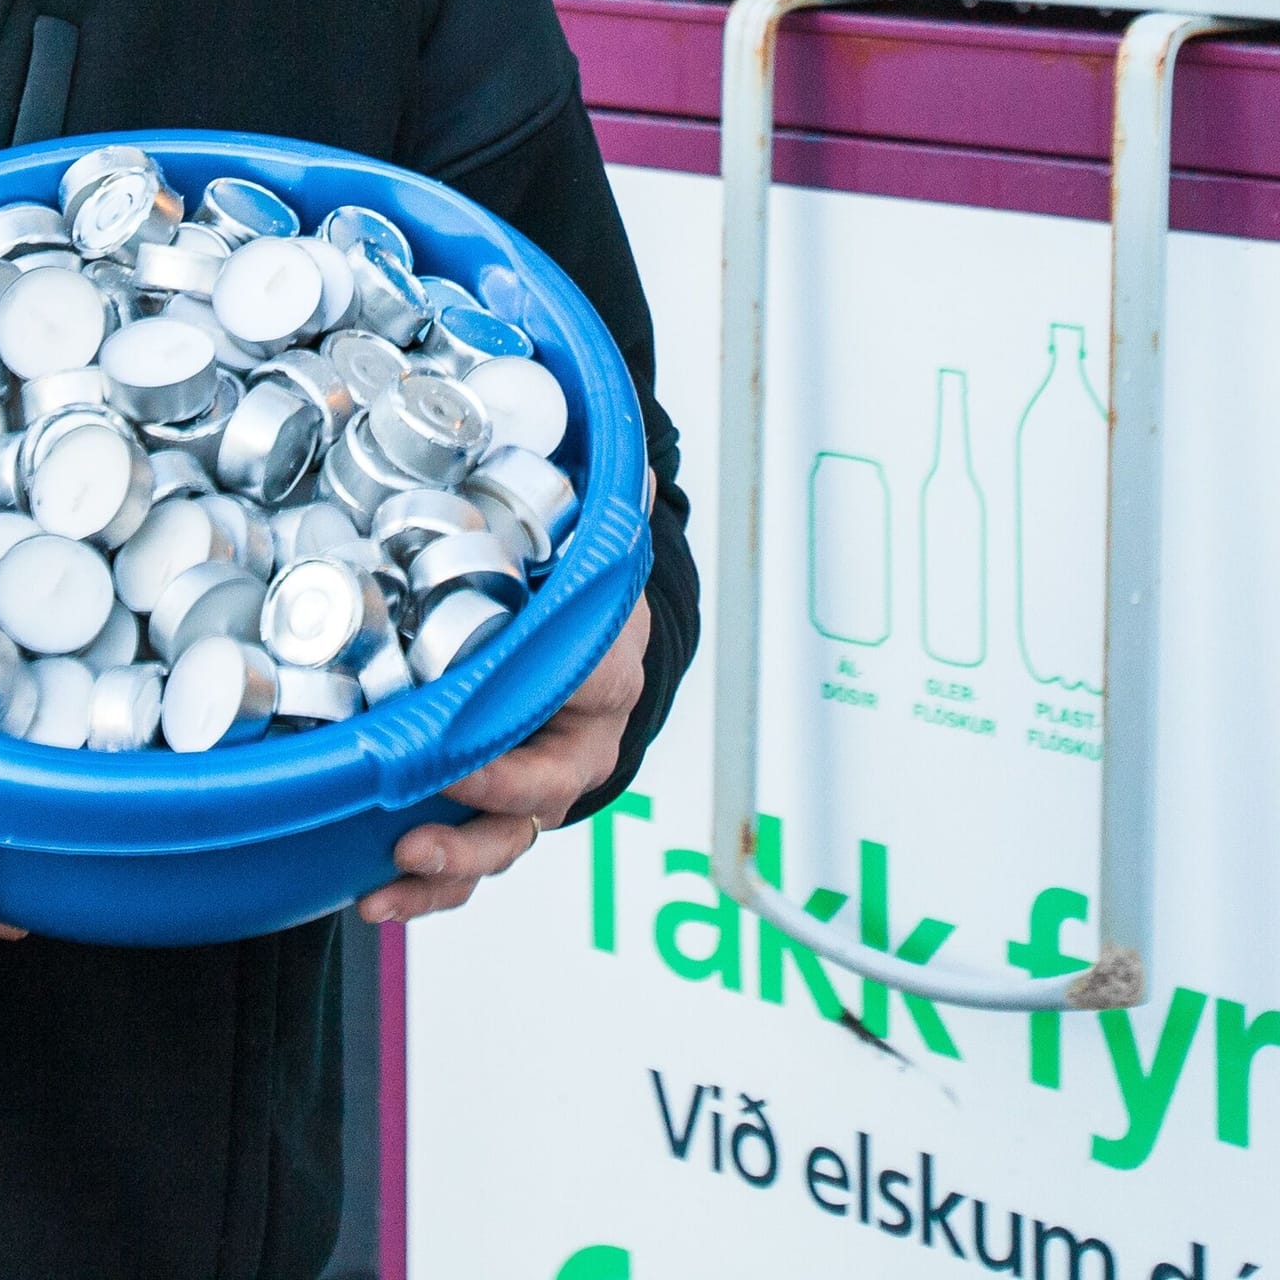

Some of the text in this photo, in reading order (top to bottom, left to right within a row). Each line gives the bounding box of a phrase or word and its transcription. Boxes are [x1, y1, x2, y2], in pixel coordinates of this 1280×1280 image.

[586, 792, 961, 1062] Takk
[648, 1068, 1118, 1280] Við elskum
